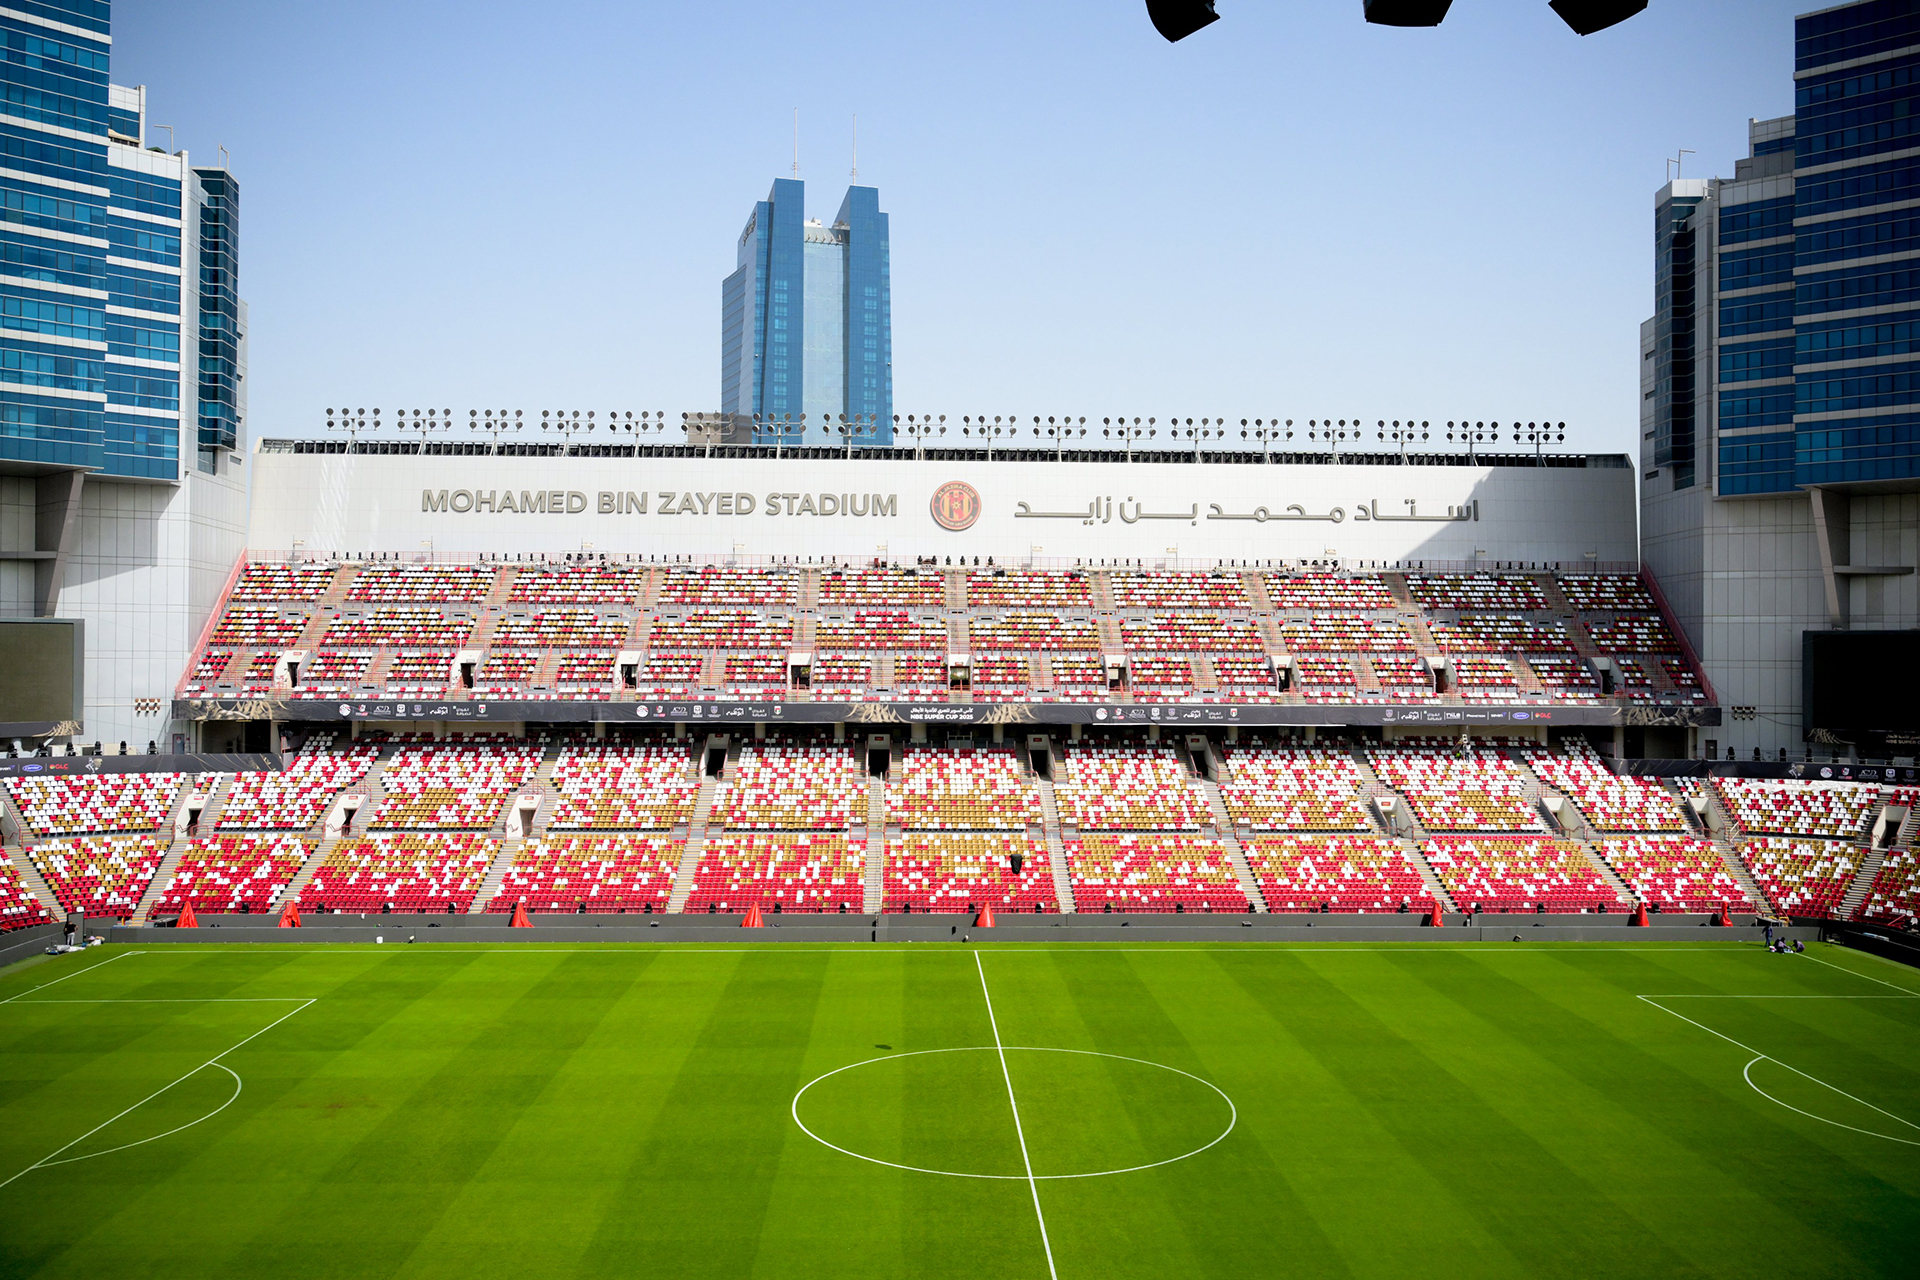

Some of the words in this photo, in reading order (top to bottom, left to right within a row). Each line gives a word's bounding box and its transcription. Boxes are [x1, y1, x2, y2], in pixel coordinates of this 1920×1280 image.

[421, 489, 588, 514] MOHAMED
[597, 490, 649, 514] BIN
[657, 492, 757, 515] ZAYED
[765, 492, 898, 517] STADIUM
[1014, 495, 1113, 526] زايد
[1119, 495, 1199, 527] بن
[1206, 502, 1346, 523] محمد
[1354, 498, 1480, 522] استاد
